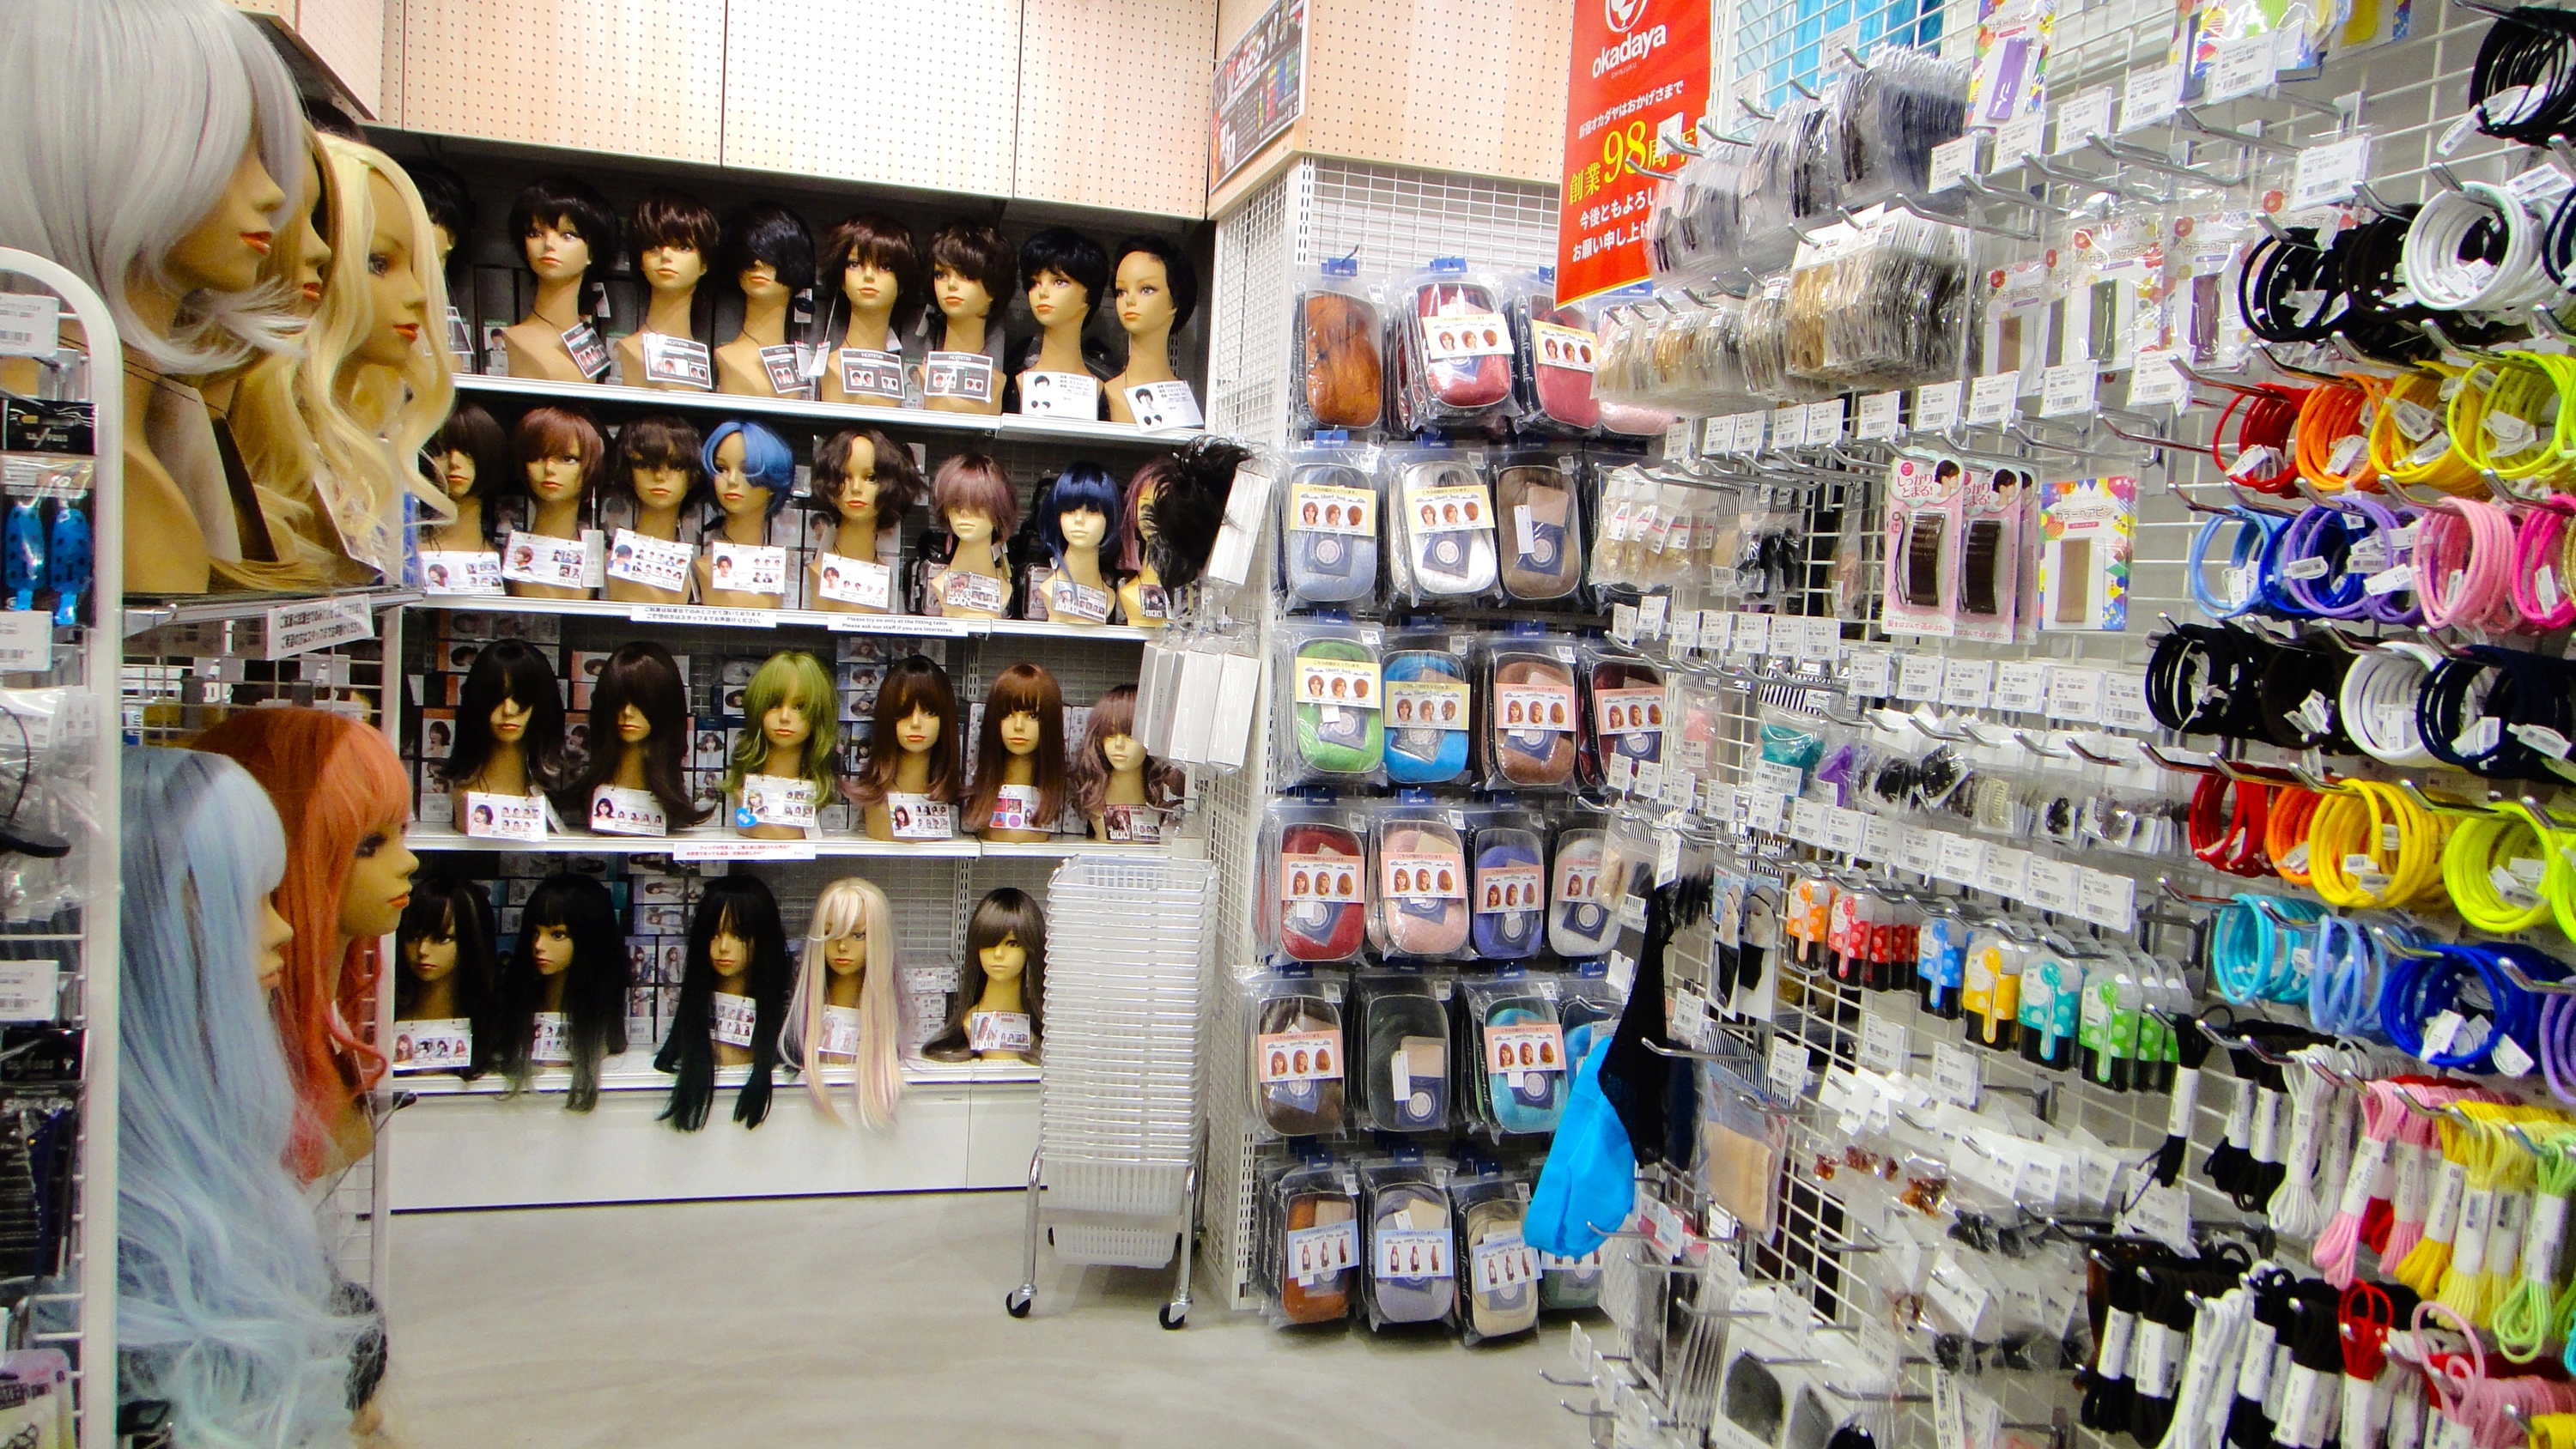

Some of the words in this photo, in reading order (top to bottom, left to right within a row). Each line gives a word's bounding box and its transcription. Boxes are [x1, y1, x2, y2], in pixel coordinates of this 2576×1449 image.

[1592, 24, 1667, 79] okadaya
[1578, 80, 1684, 139] 新宿オカダヤはおかげさまで
[1897, 473, 1933, 487] しっかり
[1901, 485, 1933, 498] とまる!
[1964, 482, 1990, 495] っかり
[2056, 504, 2114, 521] カラーヘアピン
